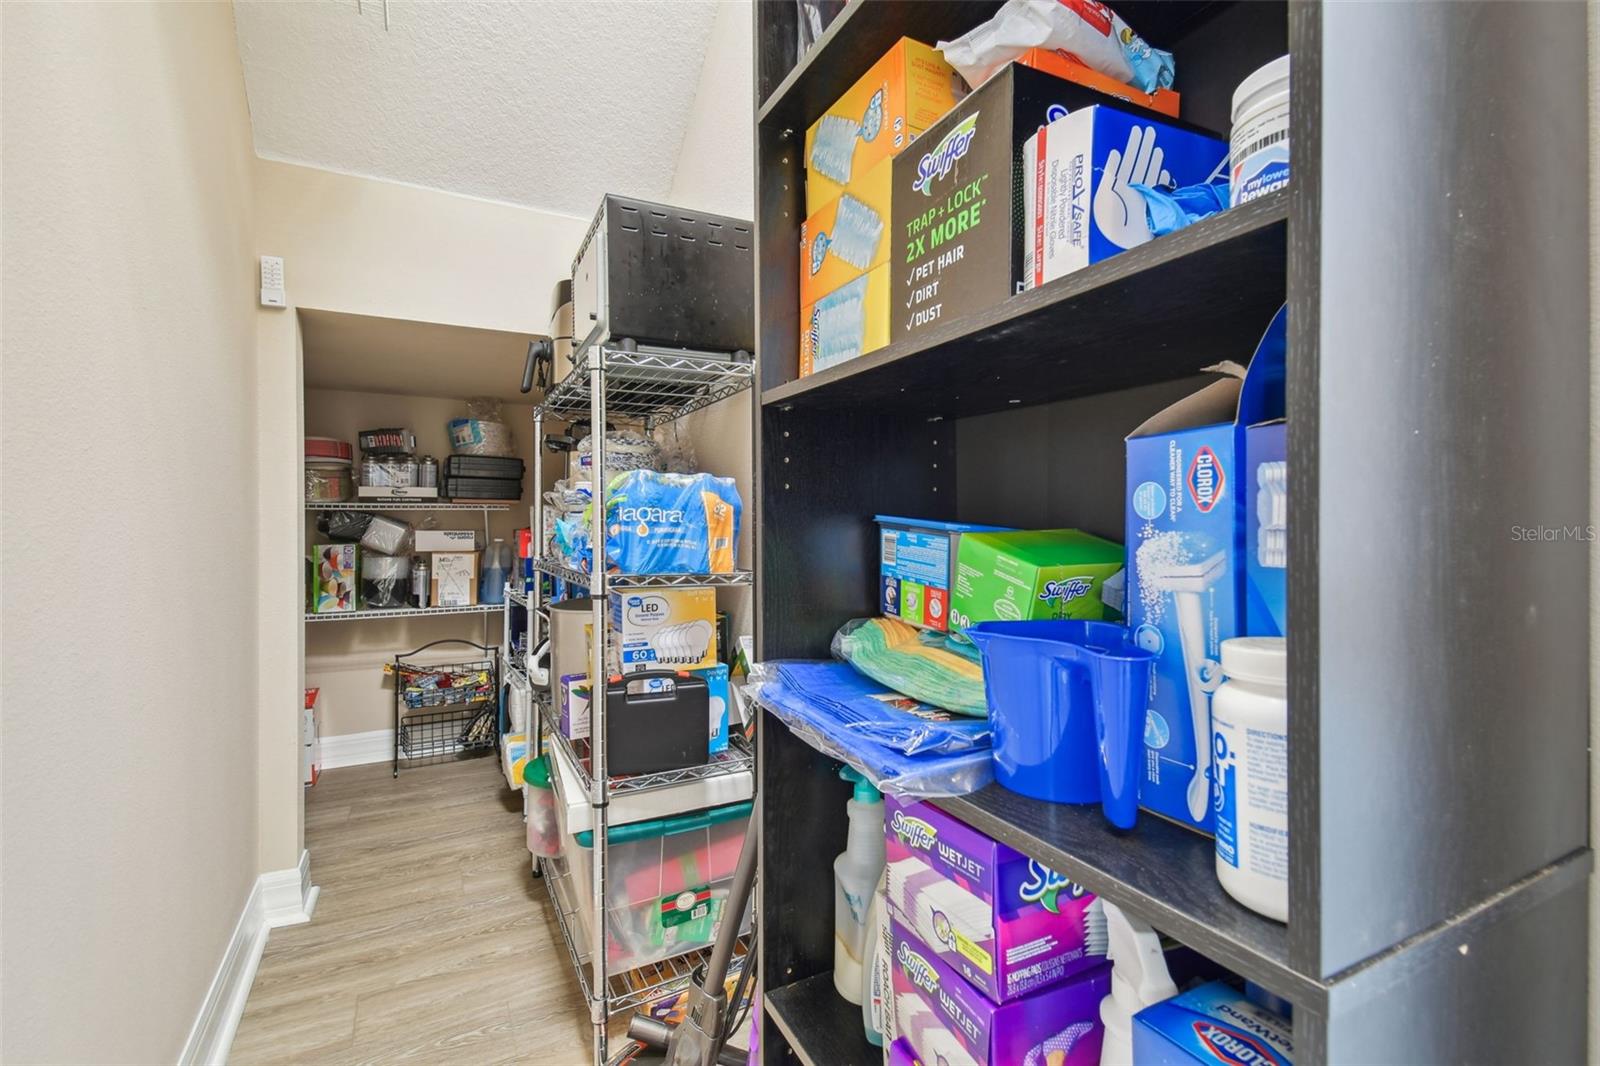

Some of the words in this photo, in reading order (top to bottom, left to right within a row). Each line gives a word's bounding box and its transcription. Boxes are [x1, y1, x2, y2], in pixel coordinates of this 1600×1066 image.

[913, 127, 976, 191] Swiffer
[906, 208, 936, 238] TRAP
[906, 234, 926, 264] 2X
[915, 260, 934, 282] PET
[937, 244, 964, 270] HAIR
[915, 281, 940, 305] DIRT
[915, 304, 942, 327] DUST
[1196, 454, 1213, 504] CLOROX
[617, 506, 684, 525] iagara
[1038, 580, 1092, 603] Swiffer
[641, 603, 659, 613] LED
[632, 650, 648, 660] 60
[891, 810, 936, 850] Swiffer
[938, 841, 983, 877] WETJET
[897, 941, 937, 993] Swiffer
[940, 988, 981, 1039] WETJET
